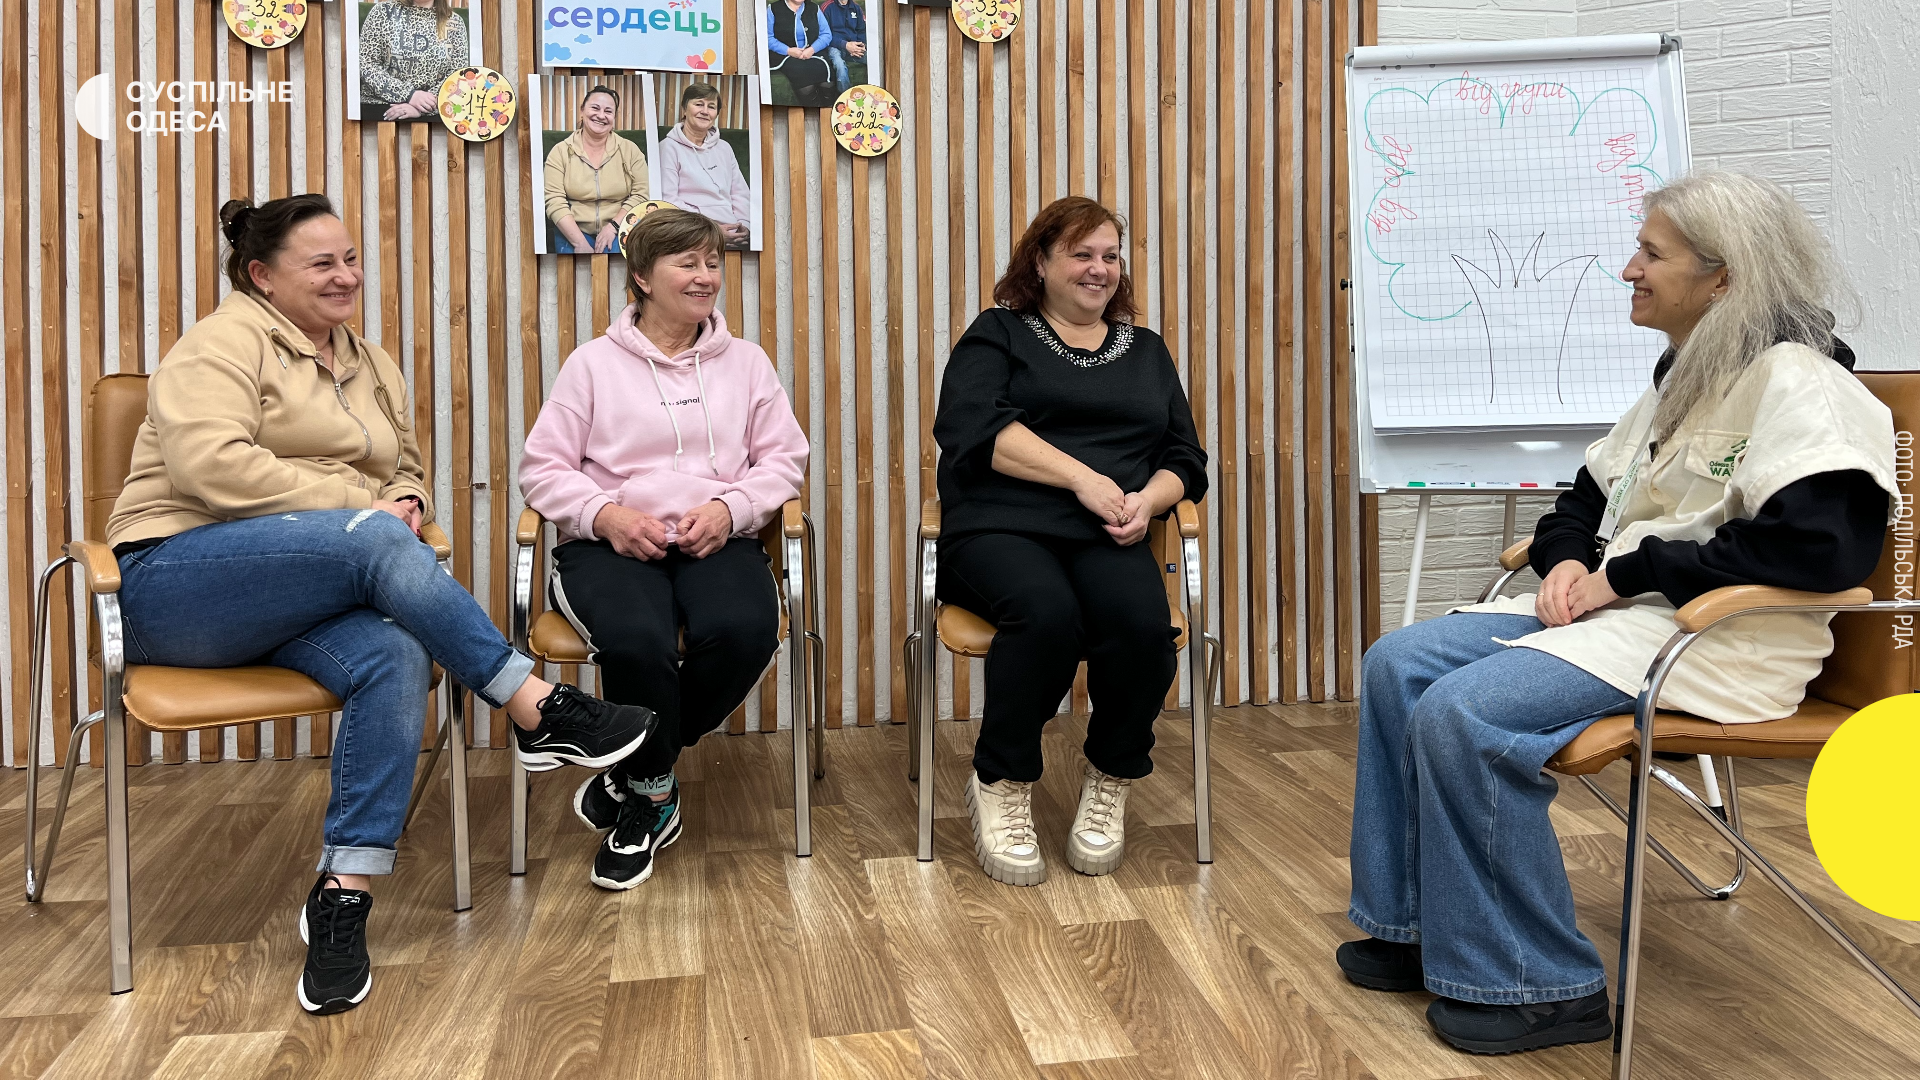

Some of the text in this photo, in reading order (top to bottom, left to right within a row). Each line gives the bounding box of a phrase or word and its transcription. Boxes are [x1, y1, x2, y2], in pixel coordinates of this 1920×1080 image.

[548, 6, 721, 37] сердець
[465, 93, 488, 117] 17
[854, 111, 884, 129] 22
[675, 396, 700, 406] signal
[1710, 467, 1734, 477] WA
